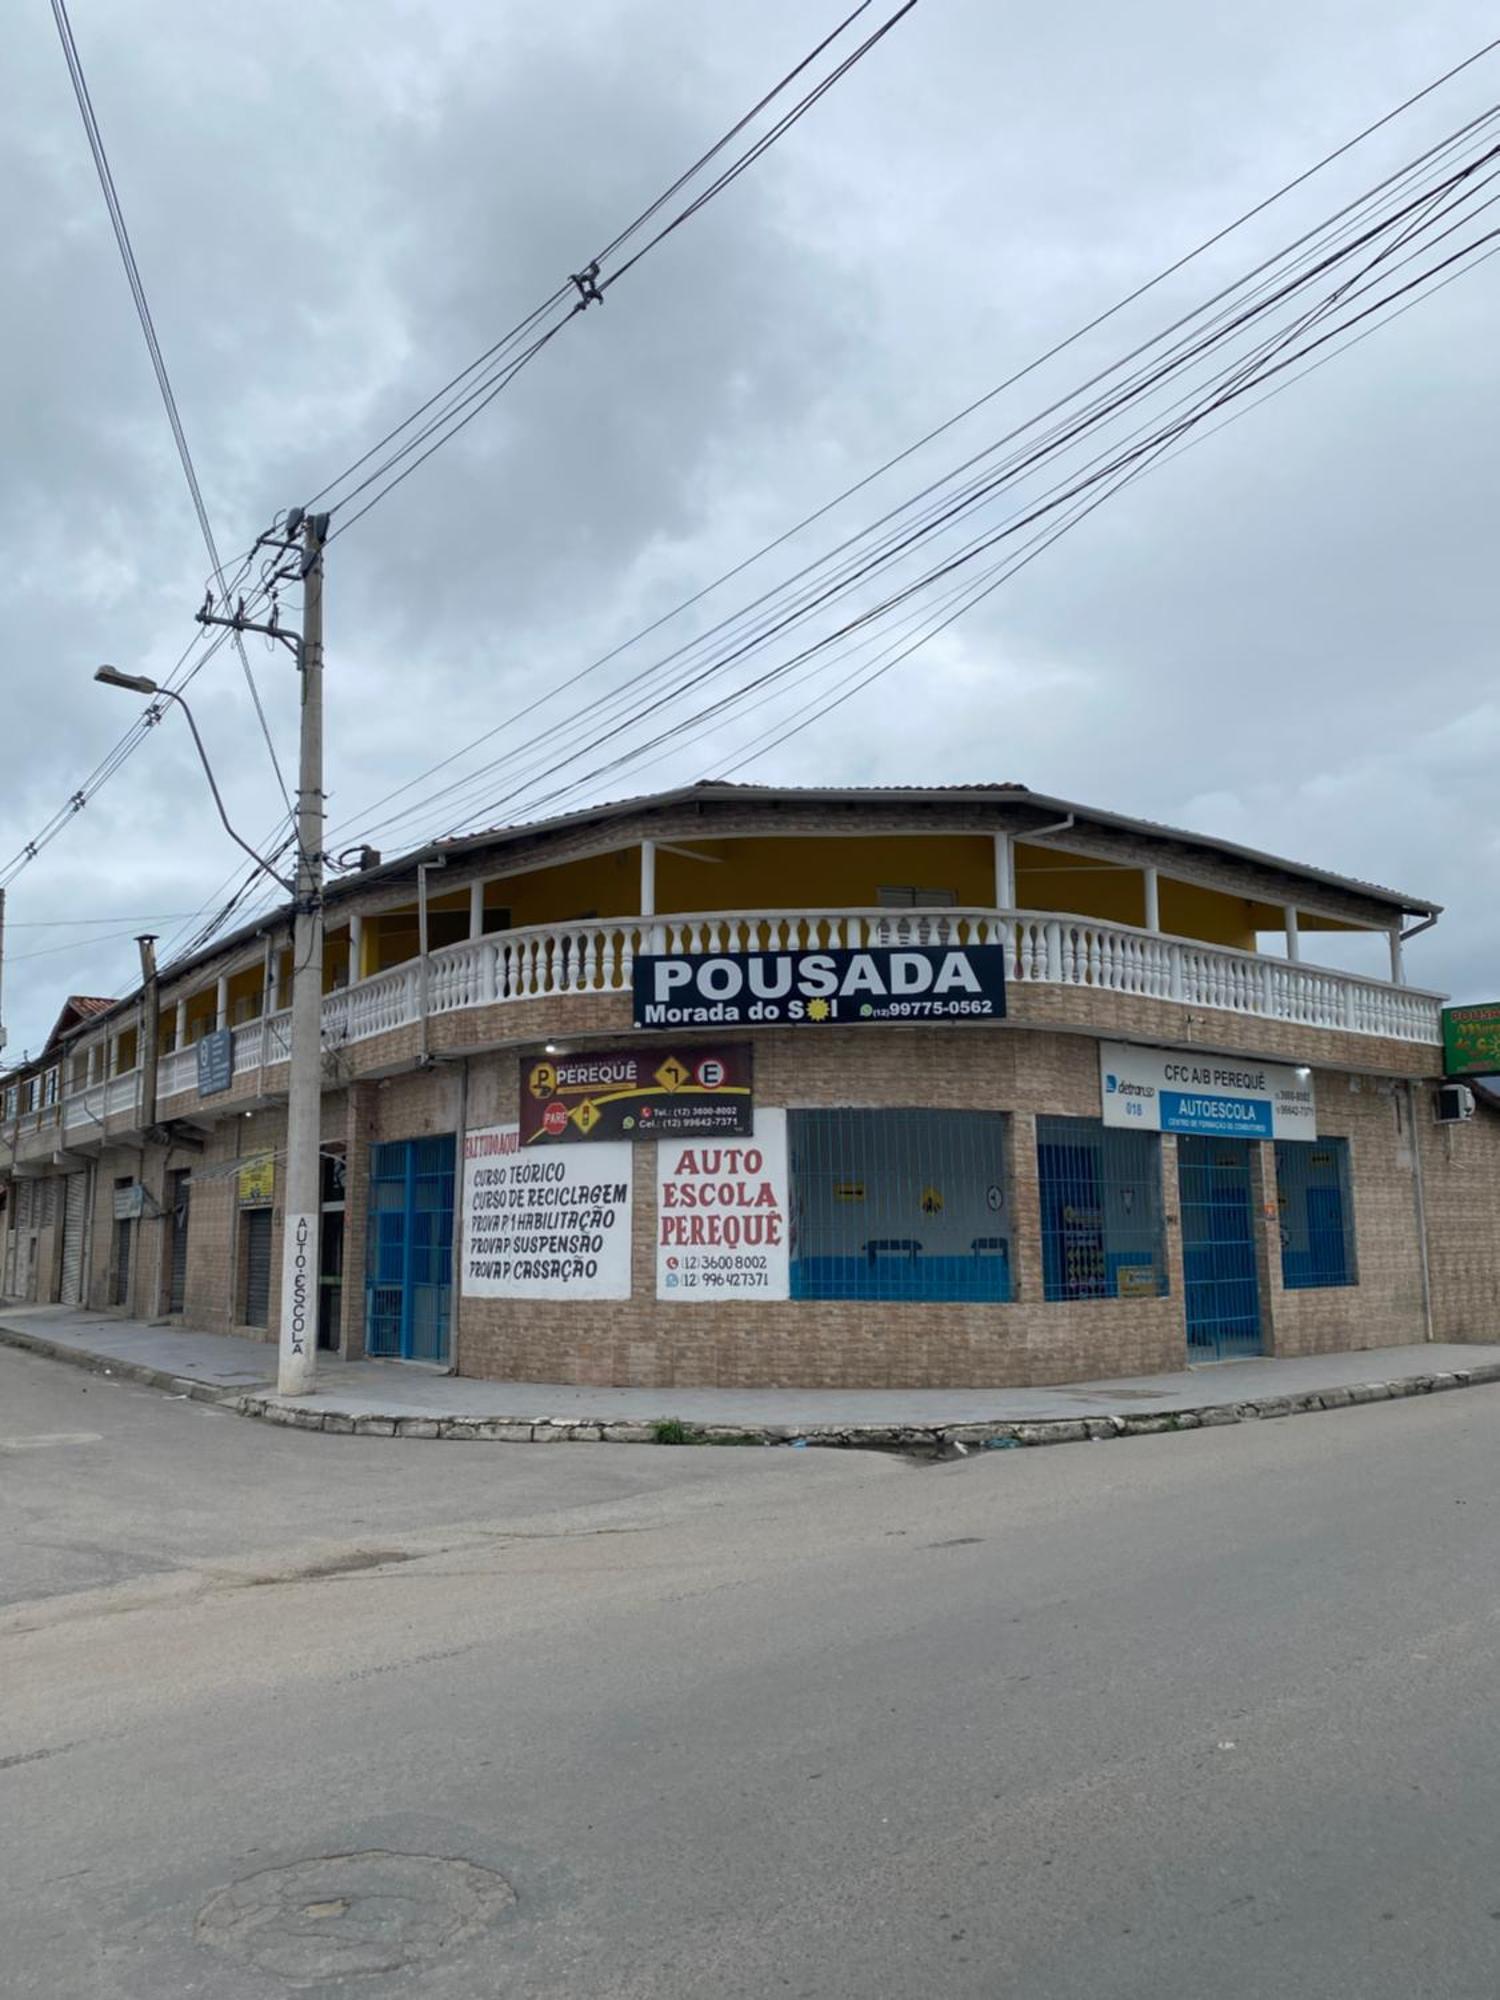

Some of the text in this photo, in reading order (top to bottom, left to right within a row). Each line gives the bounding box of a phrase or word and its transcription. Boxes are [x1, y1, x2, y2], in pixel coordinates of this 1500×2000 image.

[654, 952, 982, 1002] POUSADA
[645, 1003, 740, 1023] Morada
[748, 1001, 780, 1020] do
[556, 1061, 637, 1085] PEREQUÊ
[1164, 1064, 1189, 1082] CFC
[1214, 1070, 1265, 1090] PEREQUÊ
[544, 1111, 567, 1125] PARE
[1178, 1099, 1257, 1121] AUTOESCOLA
[674, 1149, 763, 1175] AUTO
[474, 1168, 506, 1187] CURSO
[472, 1184, 627, 1210] CURSO DE RECICLAGEM
[662, 1182, 778, 1208] ESCOLA
[472, 1214, 501, 1232] PROVA
[518, 1205, 614, 1232] HABILITAÇÃO
[660, 1211, 782, 1249] PEREQUÊ
[471, 1237, 502, 1255] PROVA
[469, 1261, 502, 1279] PROVA
[513, 1255, 597, 1282] CASSAÇÃO
